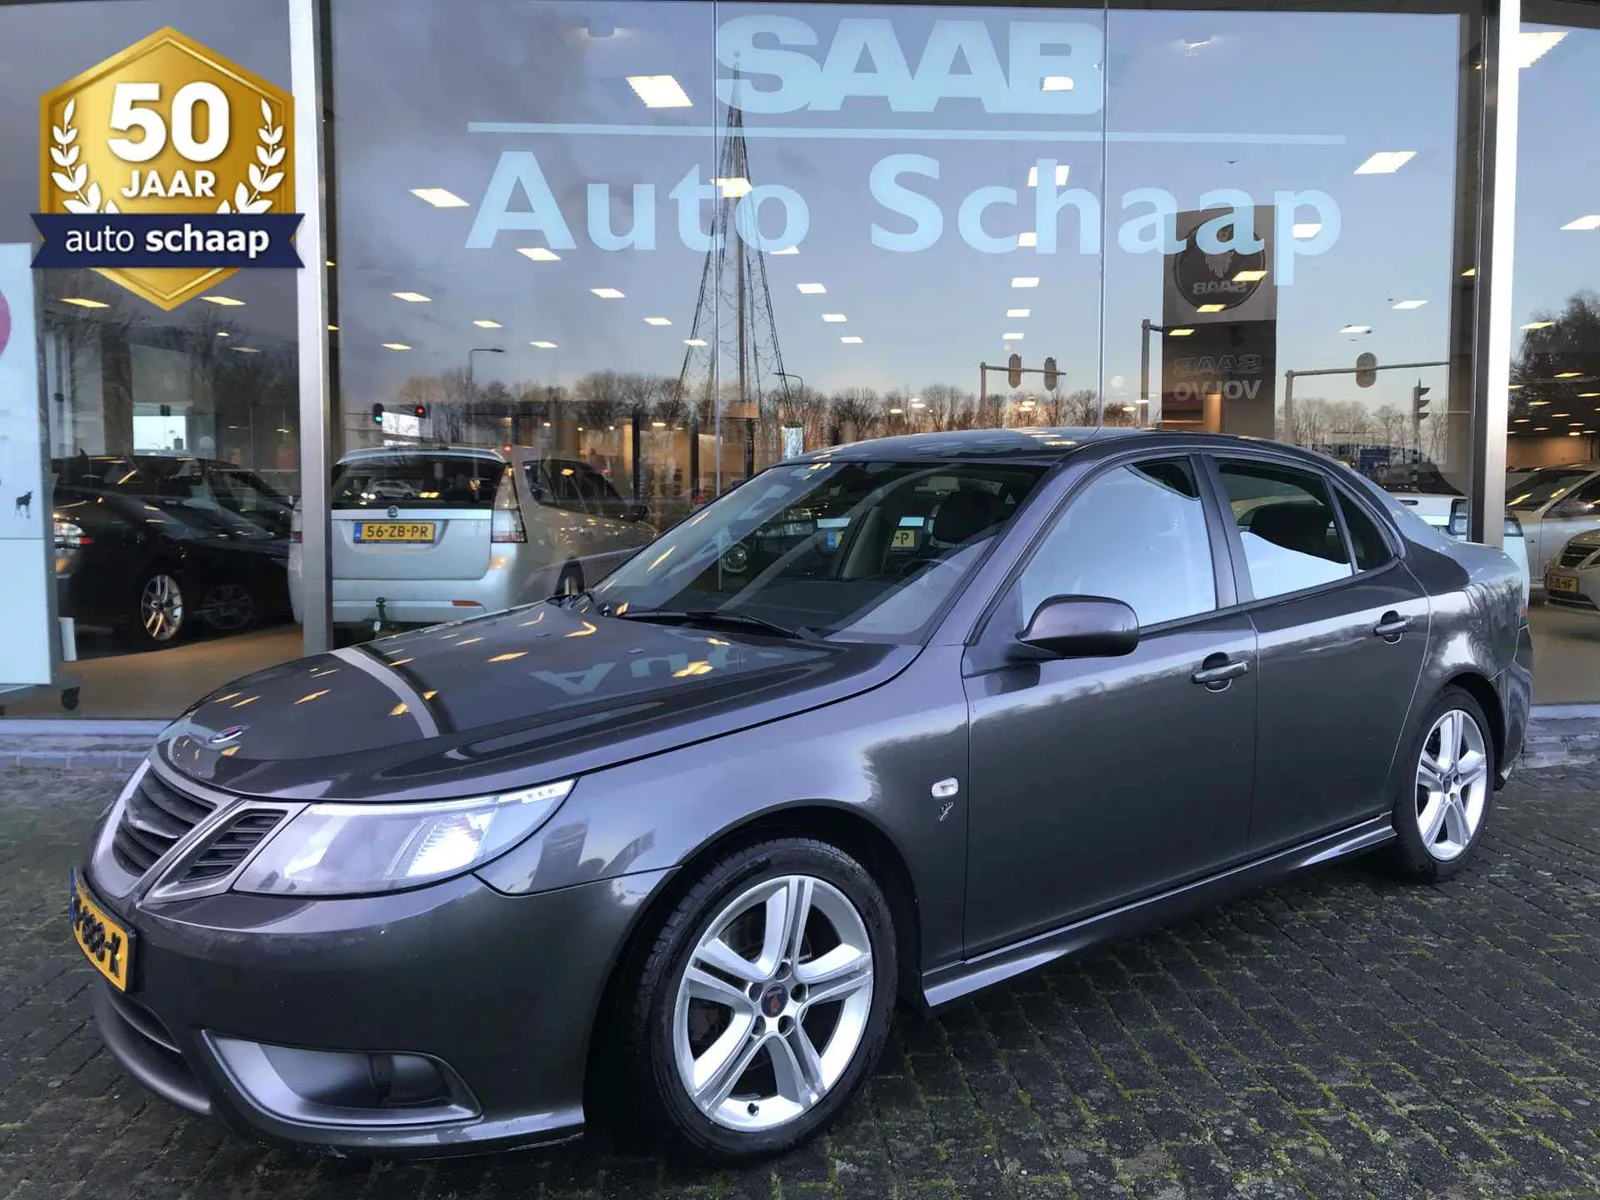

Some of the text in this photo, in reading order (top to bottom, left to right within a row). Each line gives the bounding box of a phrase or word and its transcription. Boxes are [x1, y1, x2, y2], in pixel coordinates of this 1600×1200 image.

[715, 14, 1104, 115] SAAB
[464, 151, 1343, 286] Auto Schaap
[366, 525, 428, 538] 56-ZB-PR
